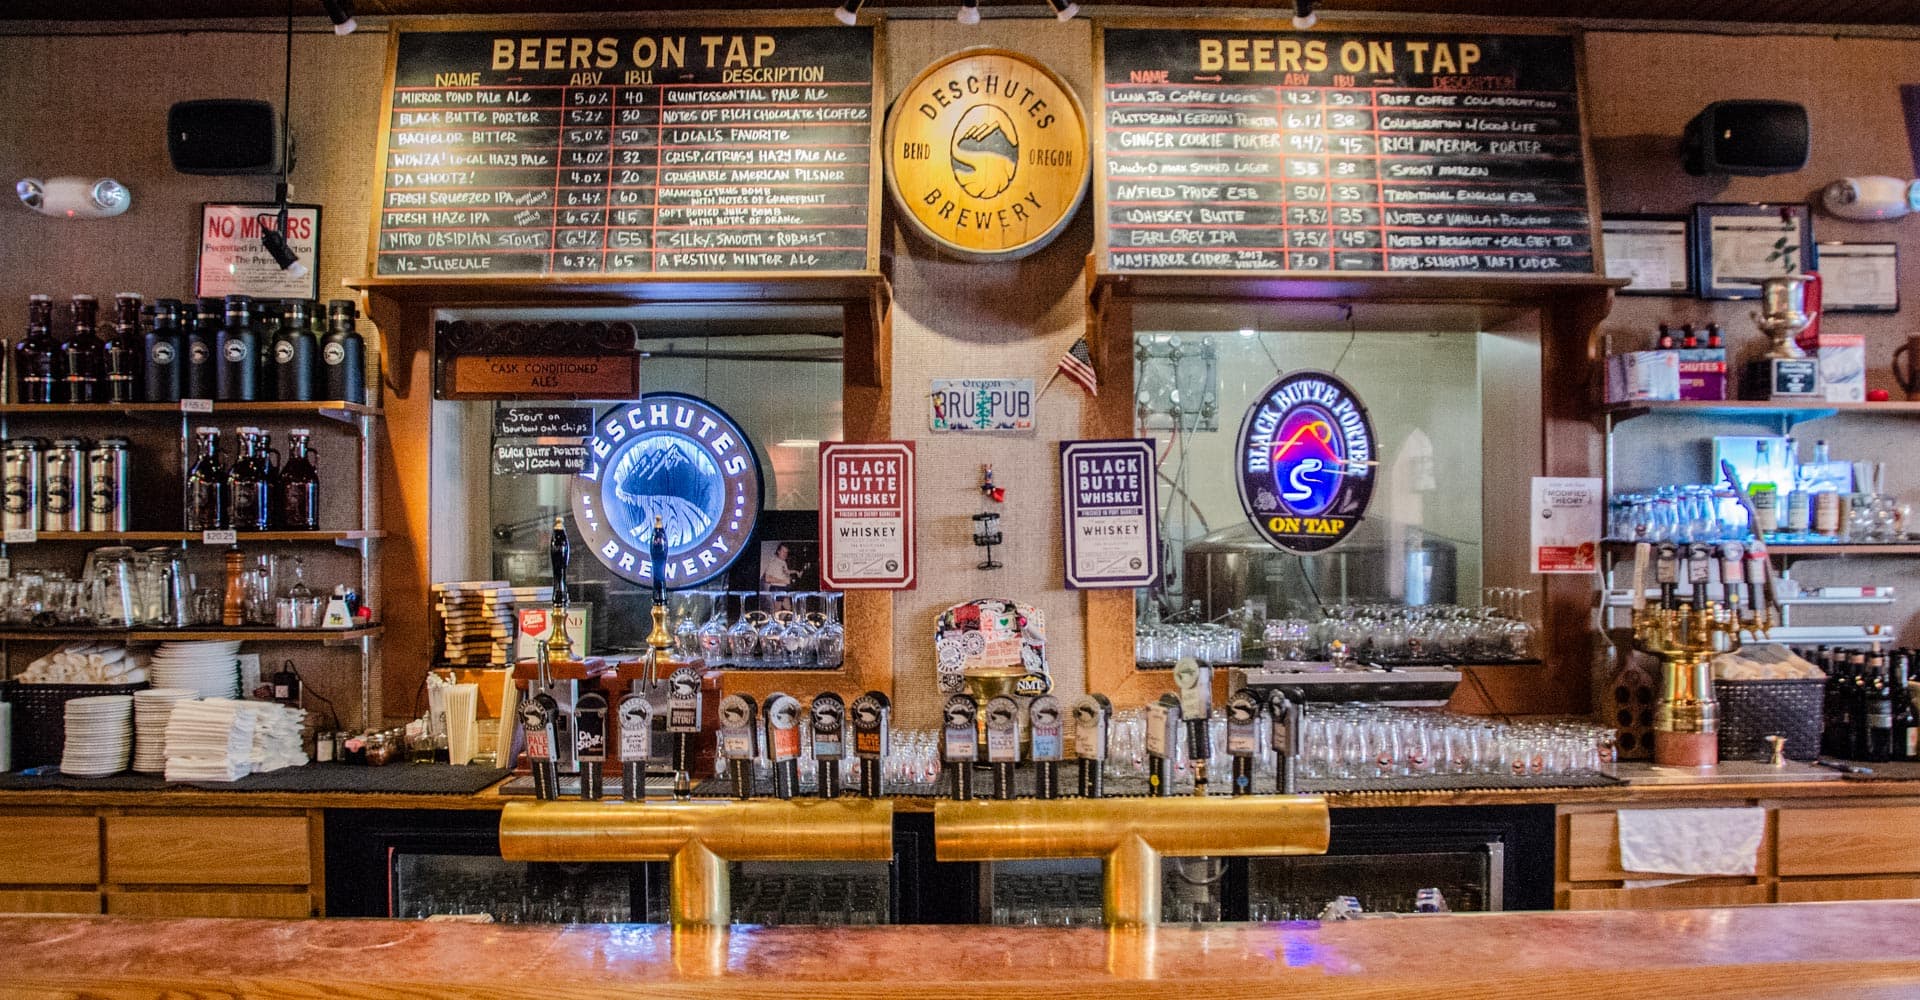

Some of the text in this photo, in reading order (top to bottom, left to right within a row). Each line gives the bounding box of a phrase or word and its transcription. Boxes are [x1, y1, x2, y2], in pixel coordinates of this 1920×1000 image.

[492, 35, 777, 71] BEERS ON TAP
[1200, 39, 1481, 74] BEERS ON TAP
[435, 72, 481, 87] NAME
[570, 71, 602, 86] ABV
[624, 71, 653, 85] IBU
[722, 66, 824, 83] DESCRIPTION
[1130, 70, 1169, 83] NAME
[1284, 73, 1310, 86] ABV
[1333, 74, 1355, 87] IBU
[401, 91, 473, 104] MIRROR POND
[574, 92, 608, 104] 5.0%
[625, 92, 643, 104] 40
[918, 74, 1056, 130] DESCHUTES
[1333, 93, 1354, 105] 30
[1415, 95, 1458, 106] COFFEE
[1463, 95, 1556, 109] COLLABORATION
[400, 112, 440, 125] BLACK
[572, 111, 603, 122] 5.2%
[622, 110, 640, 121] 30
[701, 110, 751, 122] OF RICH
[1287, 112, 1322, 128] 6.1%
[1380, 116, 1462, 130] COLLABORATION
[571, 130, 604, 143] 5.0%
[621, 130, 639, 142] 50
[1120, 132, 1281, 147] GINGER COOKIE PORTER
[1340, 138, 1363, 152] 45
[1382, 136, 1542, 153] RICH IMPERIAL PORTER
[572, 151, 603, 163] 4.0%
[623, 151, 641, 163] 32
[758, 150, 792, 163] HAZY
[903, 142, 931, 161] BEND
[1029, 148, 1073, 167] OREGON
[489, 152, 518, 166] HAZY
[394, 172, 414, 186] DA
[571, 172, 602, 184] 4.0%
[622, 172, 640, 183] 20
[621, 192, 637, 203] 60
[1116, 183, 1259, 199] ANFIELD PRIDE ESB
[1338, 186, 1361, 199] 35
[1457, 190, 1506, 201] ENGLISH
[495, 192, 514, 204] IPA
[568, 192, 601, 204] 6.4%
[691, 195, 764, 205] WITH OF
[923, 187, 1044, 230] BREWERY
[470, 211, 490, 224] IPA
[566, 211, 600, 224] 6.5%
[617, 211, 637, 224] 45
[749, 215, 762, 225] OF
[1126, 209, 1246, 224] WHISKEY BUTTE
[1293, 208, 1327, 223] 7.8%
[1339, 208, 1363, 223] 35
[1386, 211, 1492, 225] NOTES OF VANILLA
[208, 215, 311, 240] NO MINRS
[390, 231, 491, 247] NITRO OBSIDIAN
[617, 233, 642, 247] 55
[716, 234, 763, 246] SMOOTH
[1130, 229, 1238, 244] EARL GREY IPA
[1293, 231, 1328, 247] 7.5%
[1342, 230, 1365, 246] 45
[614, 254, 634, 267] 65
[660, 254, 669, 266] A
[1237, 250, 1263, 260] 2017
[564, 255, 597, 269] 6.7%
[1484, 256, 1514, 269] TART
[491, 363, 599, 374] CASK CONDITIONED
[531, 376, 559, 387] ALES
[962, 380, 1001, 390] Oregon
[990, 390, 1030, 418] PUB
[502, 422, 587, 434] bourbon oak chips
[1248, 380, 1370, 479] BLACK BUTTE PORTER
[499, 446, 589, 459] BLACK BUTTE PORTER
[564, 458, 585, 470] NIBS
[838, 460, 897, 475] BLACK
[1079, 458, 1138, 474] BLACK
[838, 477, 897, 491] BUTTE
[1079, 474, 1139, 492] BUTTE
[838, 493, 897, 505] WHISKEY
[1080, 491, 1139, 504] WHISKEY
[1547, 489, 1588, 497] MODIFIED
[839, 526, 897, 538] WHISKEY
[1082, 525, 1139, 536] WHISKEY
[1268, 517, 1345, 535] ON TAP
[602, 535, 729, 579] BREWERY
[527, 735, 548, 745] PALE
[578, 730, 592, 741] DA
[528, 745, 548, 757] ALE
